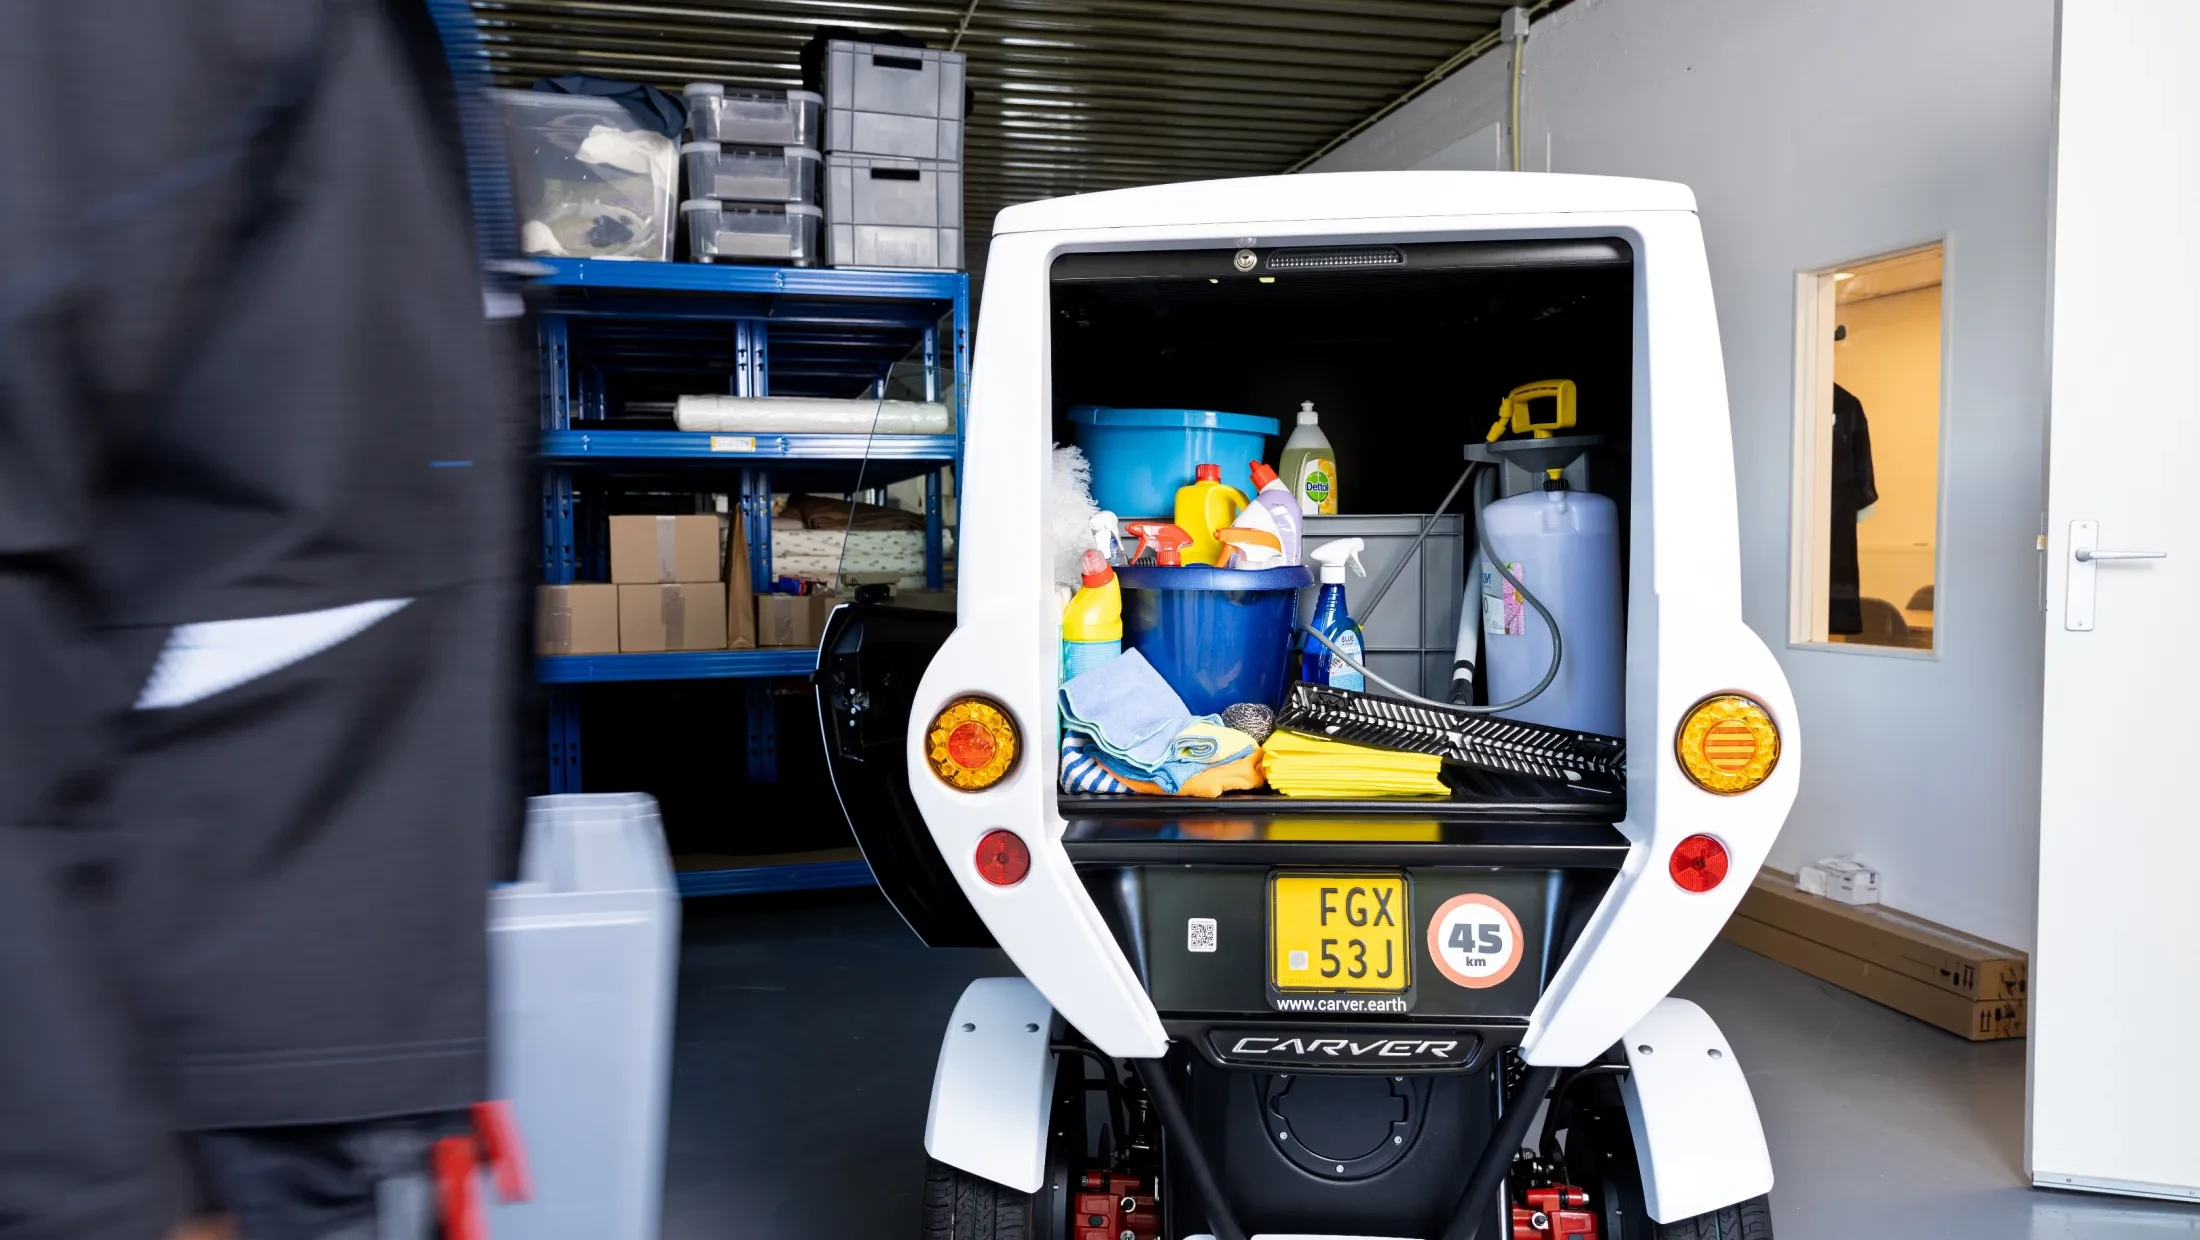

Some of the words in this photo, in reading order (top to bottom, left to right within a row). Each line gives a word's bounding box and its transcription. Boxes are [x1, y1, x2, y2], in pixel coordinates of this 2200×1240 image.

[1306, 482, 1329, 491] Dettol
[1320, 887, 1394, 927] FGX
[1448, 923, 1503, 954] 45
[1320, 938, 1393, 978] 53J
[1465, 956, 1487, 967] km
[1276, 997, 1407, 1012] www.carver.earth
[1232, 1038, 1458, 1058] CARVER
